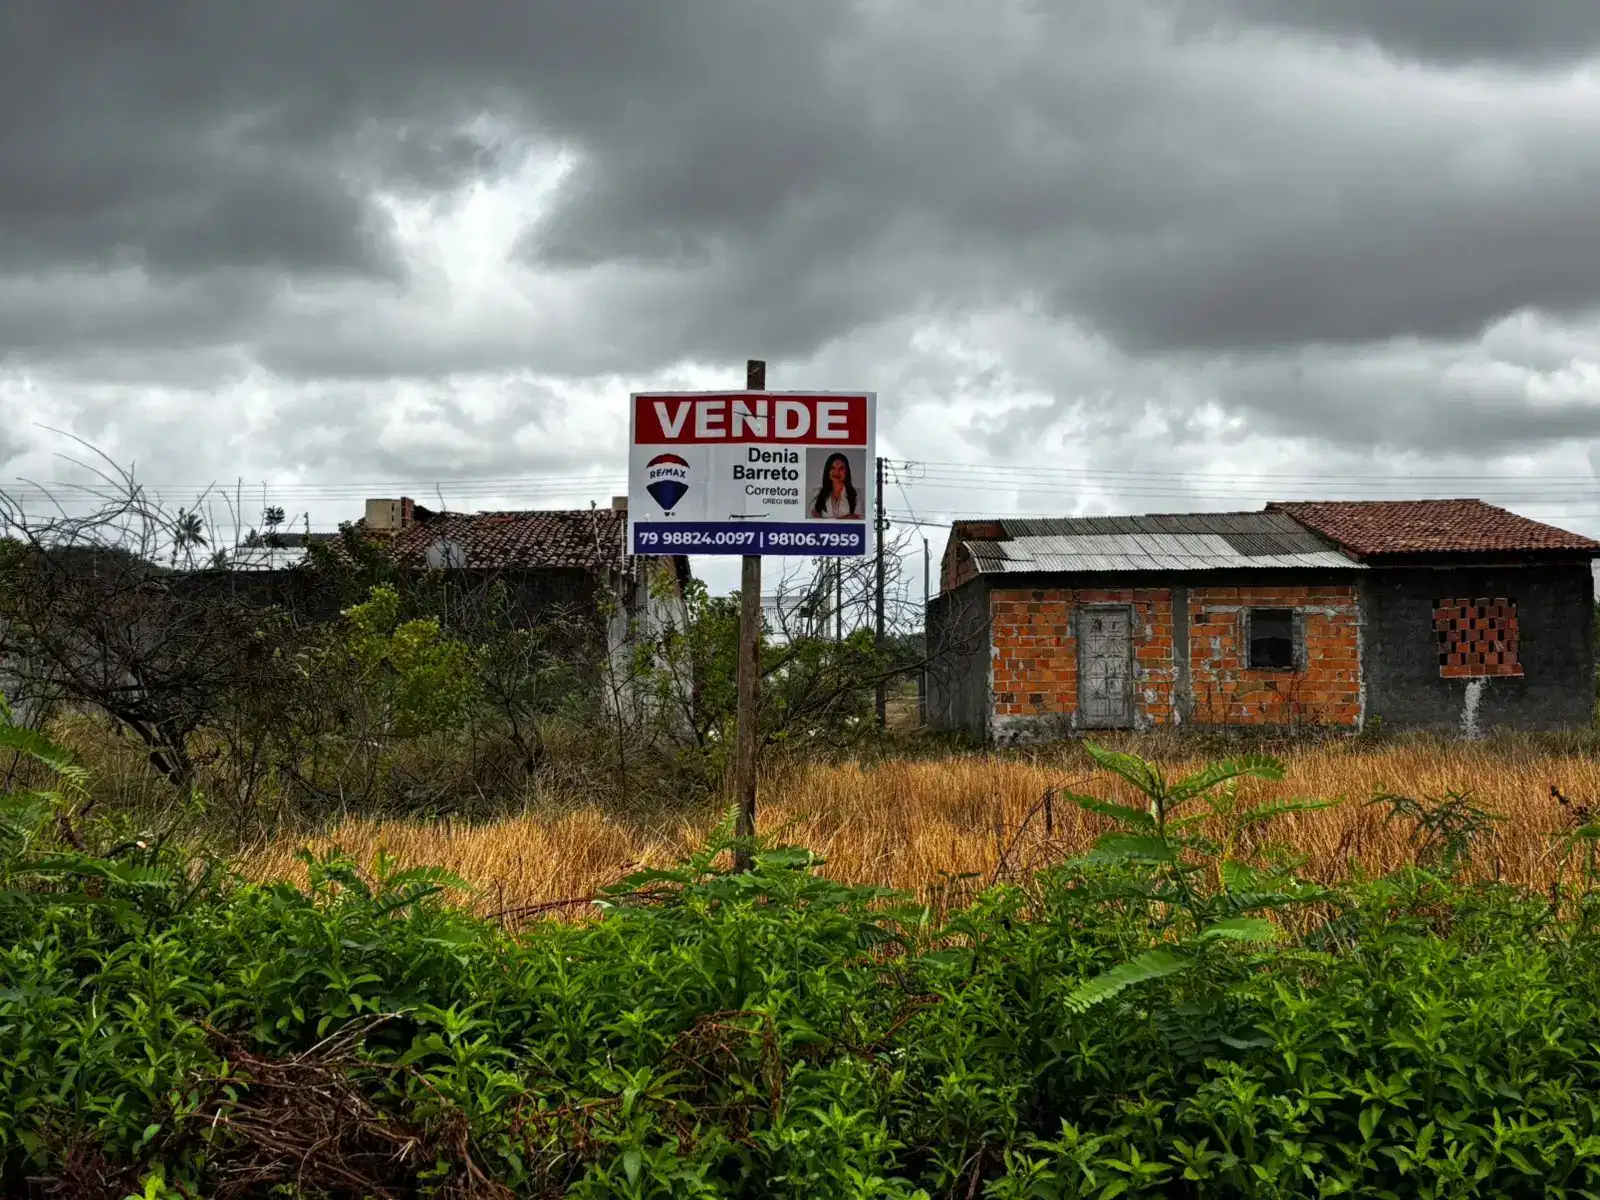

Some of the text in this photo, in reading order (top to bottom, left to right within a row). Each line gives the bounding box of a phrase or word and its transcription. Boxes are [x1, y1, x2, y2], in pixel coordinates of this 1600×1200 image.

[653, 400, 849, 438] VENDE
[748, 448, 799, 463] Denia
[650, 468, 687, 479] RE/MAX
[733, 465, 799, 480] Barreto
[745, 485, 799, 496] Corretora
[639, 532, 659, 545] 79
[662, 532, 755, 545] 98824.0097
[768, 533, 859, 547] 98106.7959
